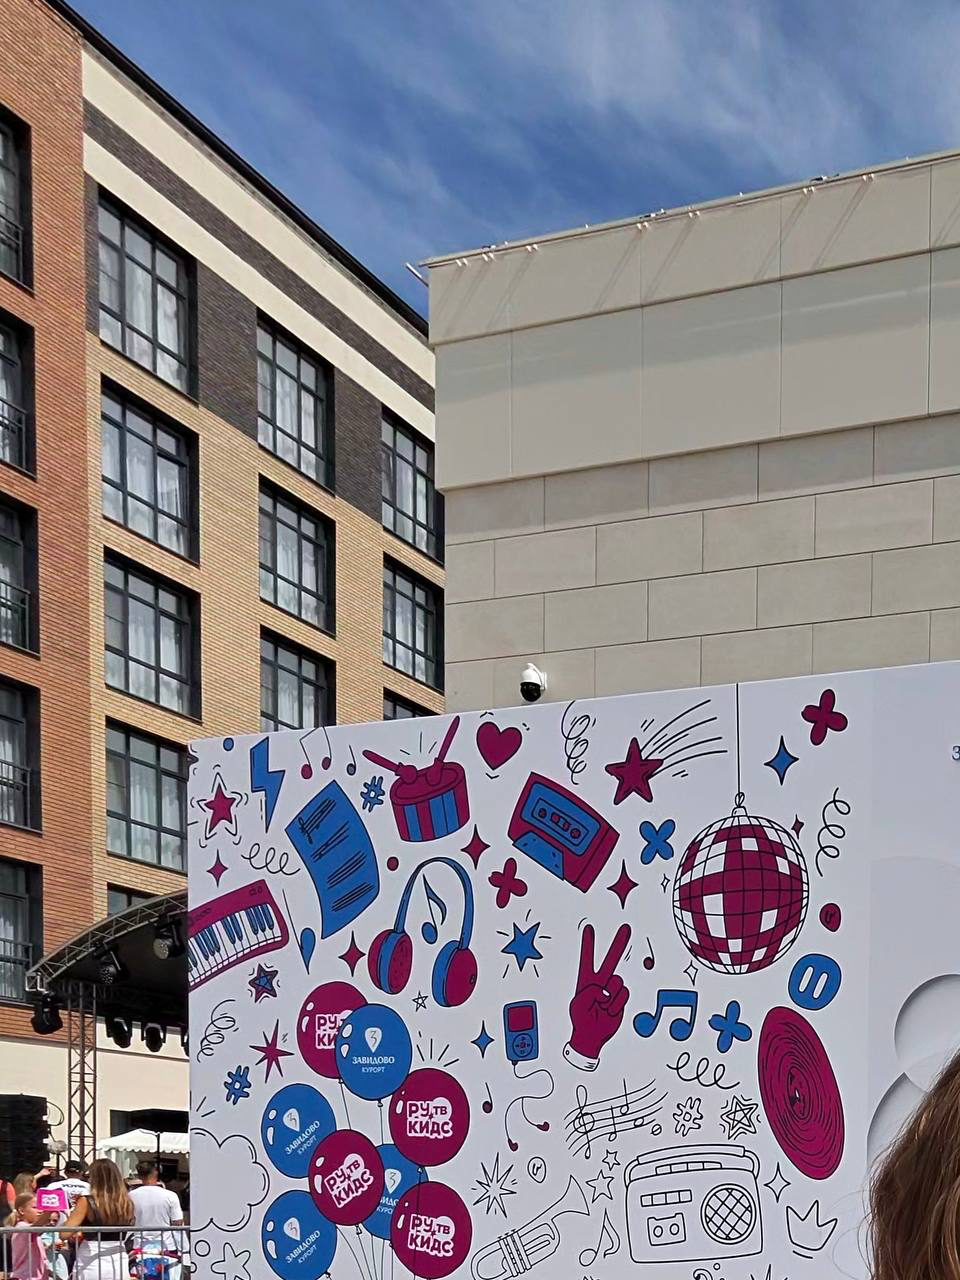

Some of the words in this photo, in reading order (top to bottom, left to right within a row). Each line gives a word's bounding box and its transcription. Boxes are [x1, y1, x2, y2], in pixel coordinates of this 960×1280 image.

[317, 1033, 337, 1047] КИ
[352, 1056, 395, 1065] ЗАВИДОВО
[284, 1120, 321, 1155] ЗАВИДОВО
[408, 1120, 451, 1136] КИДС
[333, 1170, 372, 1205] КИДС
[285, 1230, 320, 1263] ЗАВИДОВО
[408, 1232, 452, 1254] КИДС
